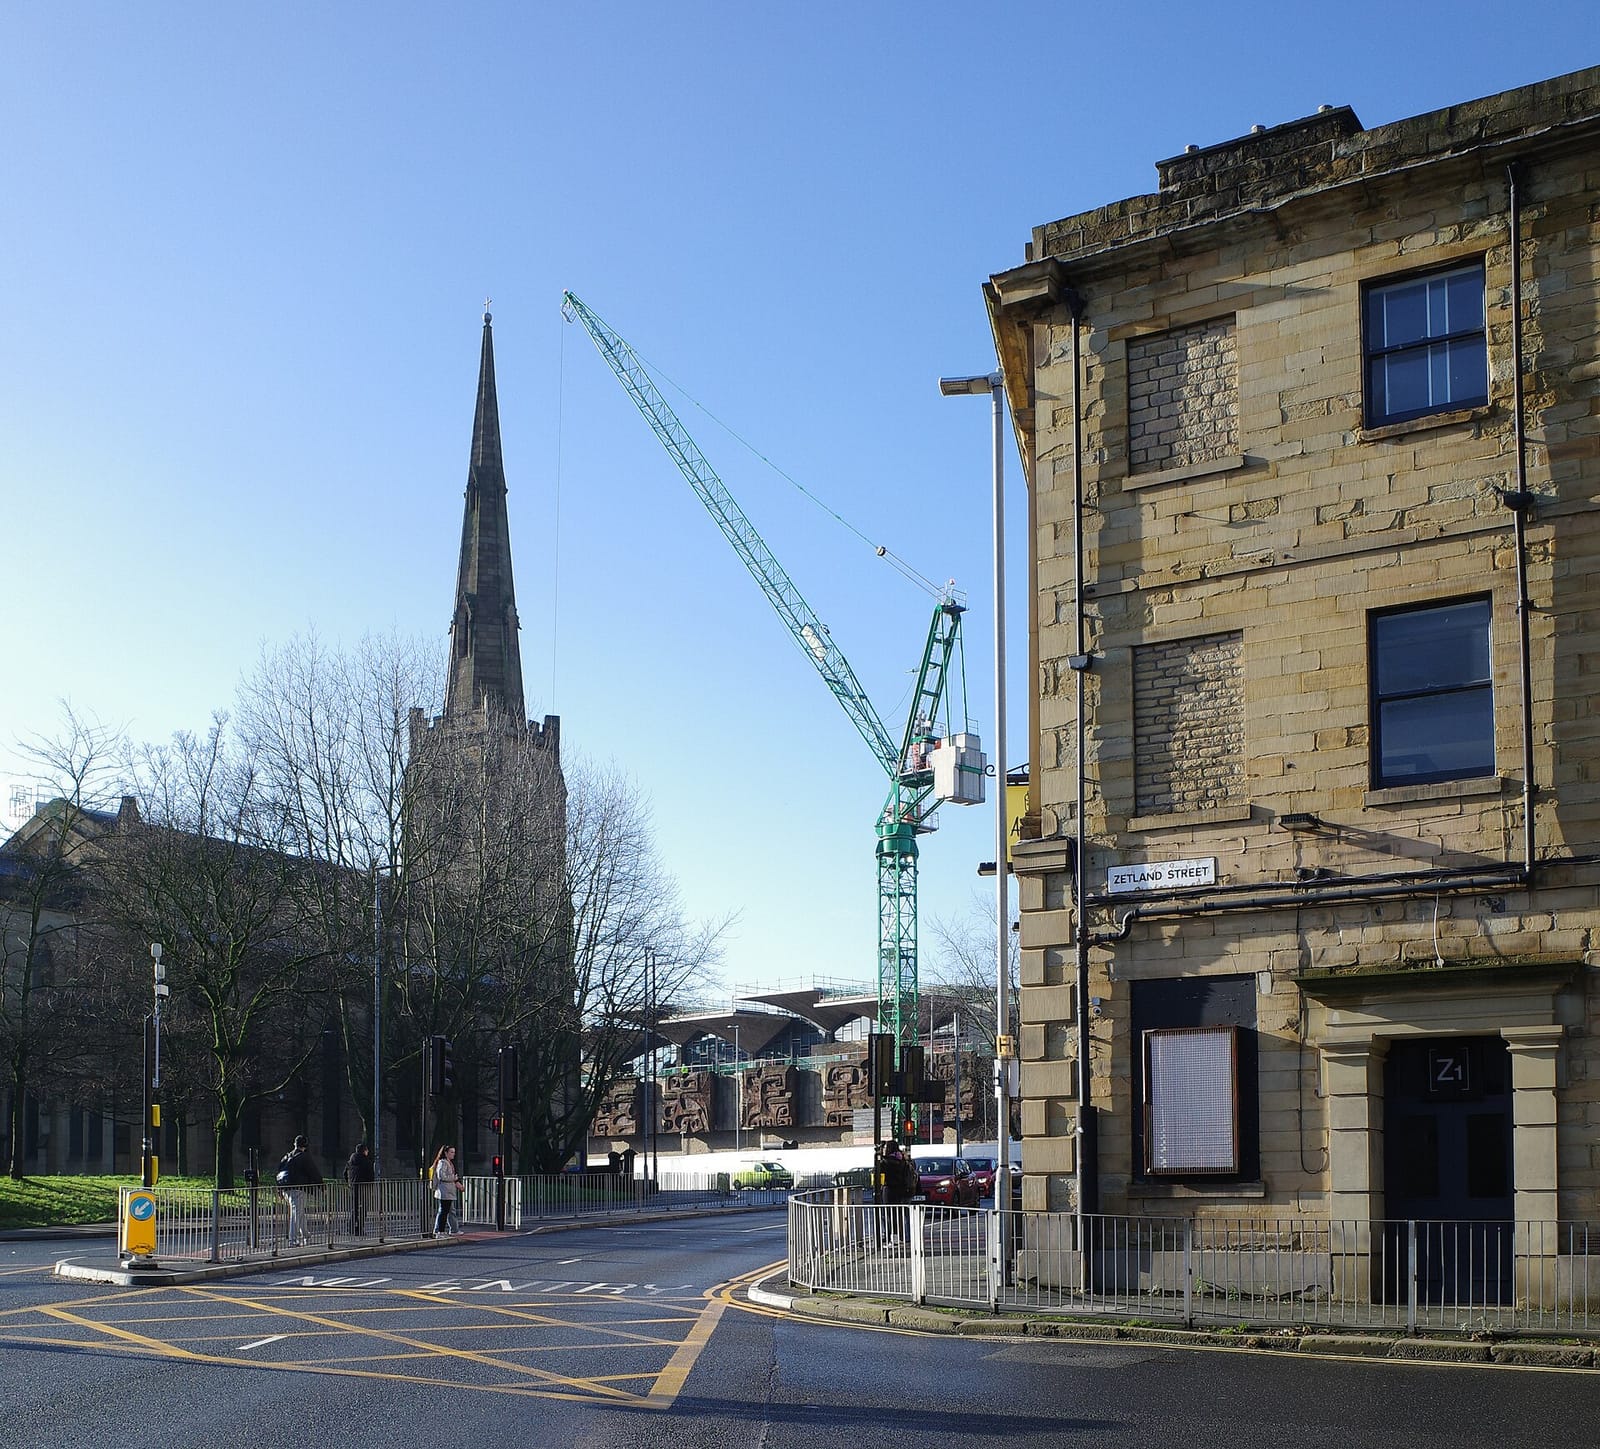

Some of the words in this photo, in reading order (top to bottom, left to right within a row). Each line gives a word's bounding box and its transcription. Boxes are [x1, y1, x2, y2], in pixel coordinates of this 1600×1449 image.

[1113, 871, 1162, 884] ZETLAND
[1167, 866, 1208, 879] STREET
[1000, 1037, 1011, 1052] H
[1436, 1058, 1462, 1081] Z1
[269, 1276, 392, 1288] NO
[417, 1278, 693, 1296] ENTRY
